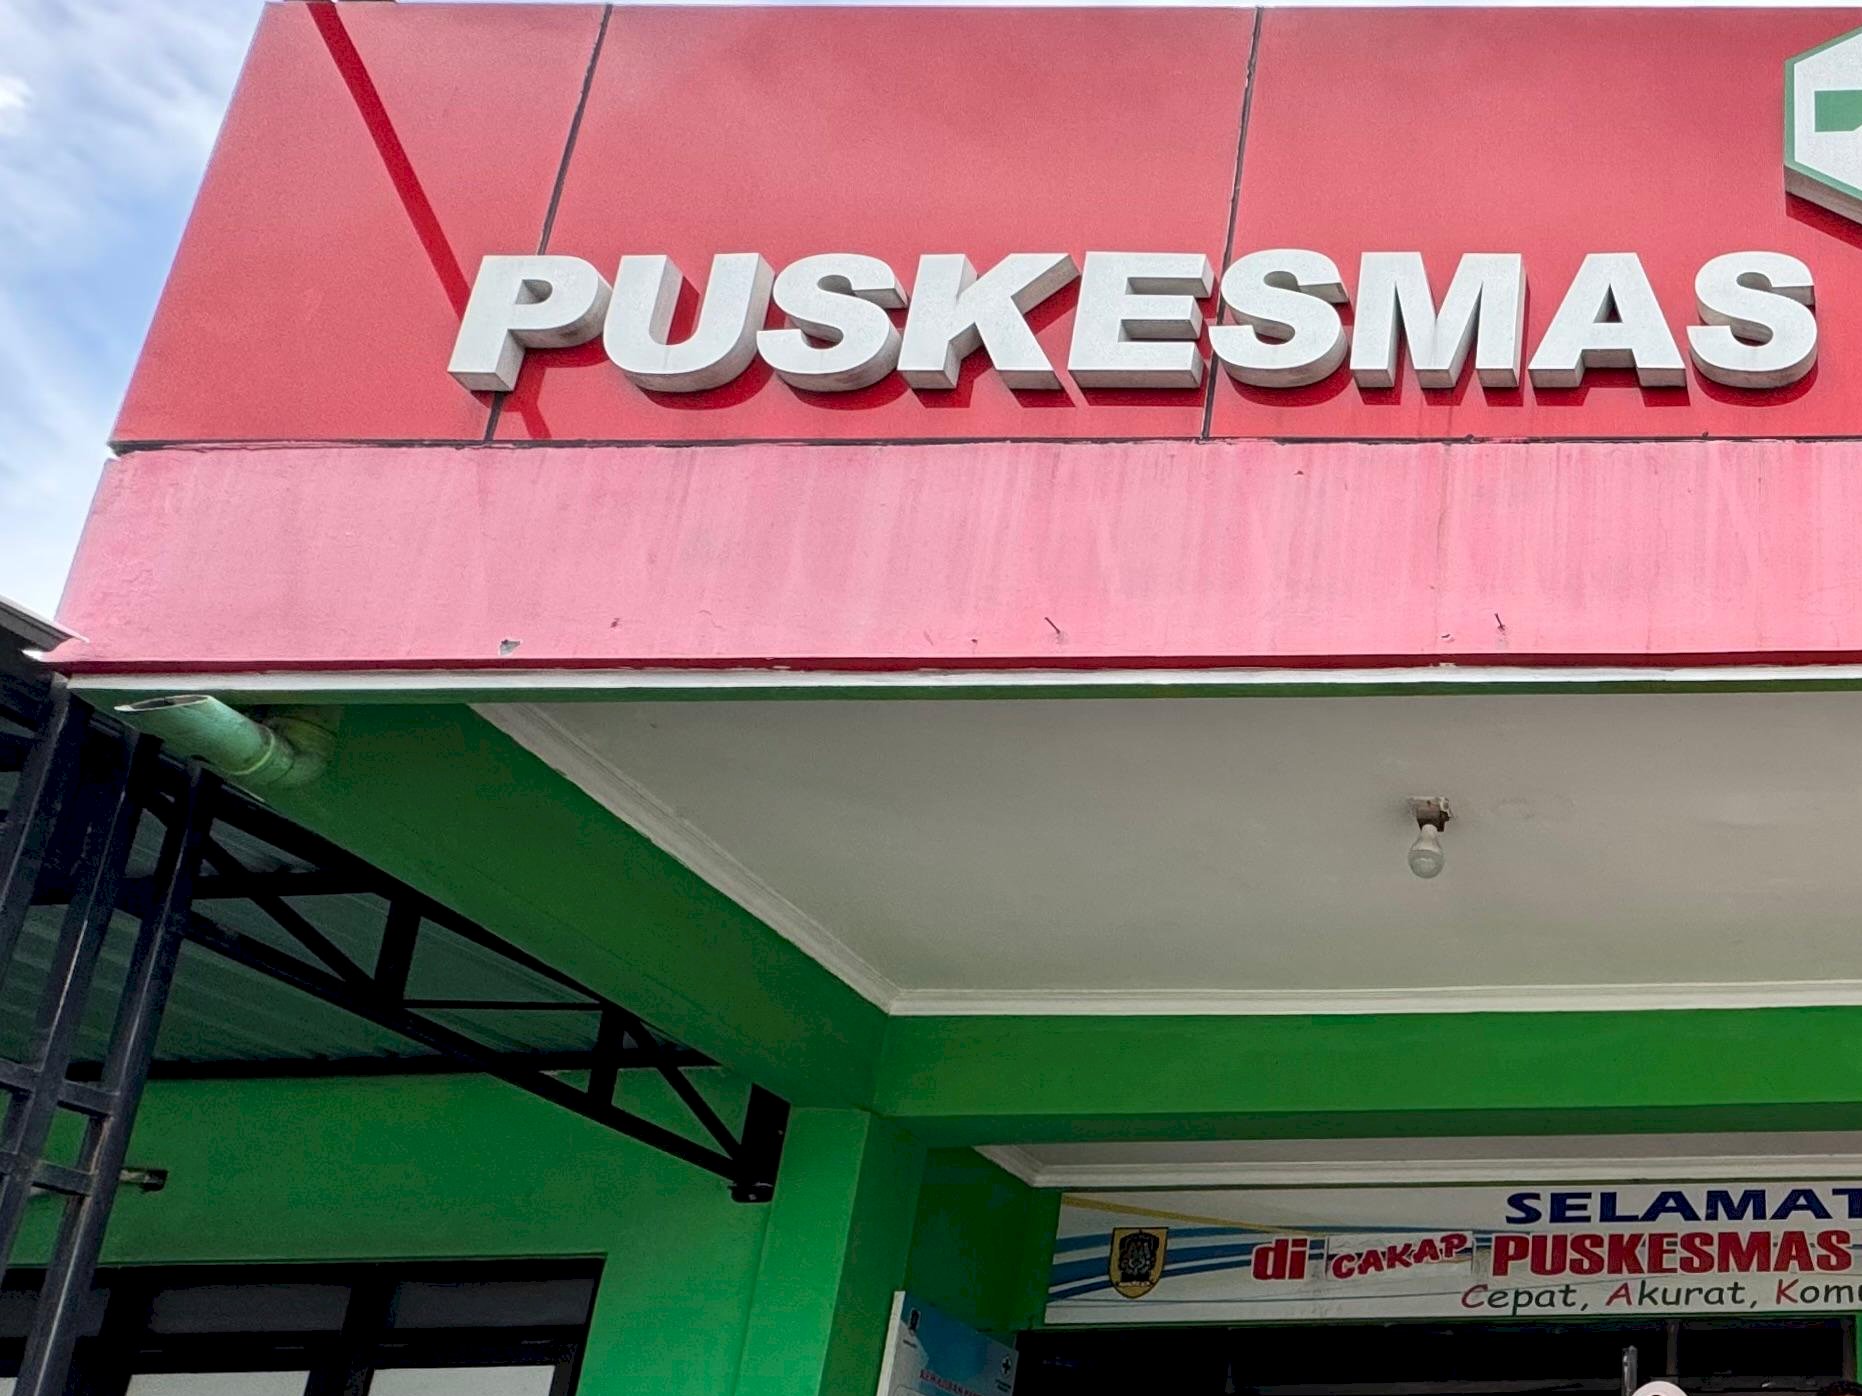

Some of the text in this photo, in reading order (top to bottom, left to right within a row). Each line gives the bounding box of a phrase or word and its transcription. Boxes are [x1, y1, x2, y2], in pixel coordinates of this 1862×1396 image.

[447, 248, 1820, 393] PUSKESMAS
[1252, 1238, 1308, 1280] di
[1331, 1232, 1468, 1280] CAKAP
[1491, 1229, 1853, 1277] PUSKESMAS
[1460, 1283, 1590, 1316] Cepat,
[1604, 1280, 1758, 1309] Akurat,
